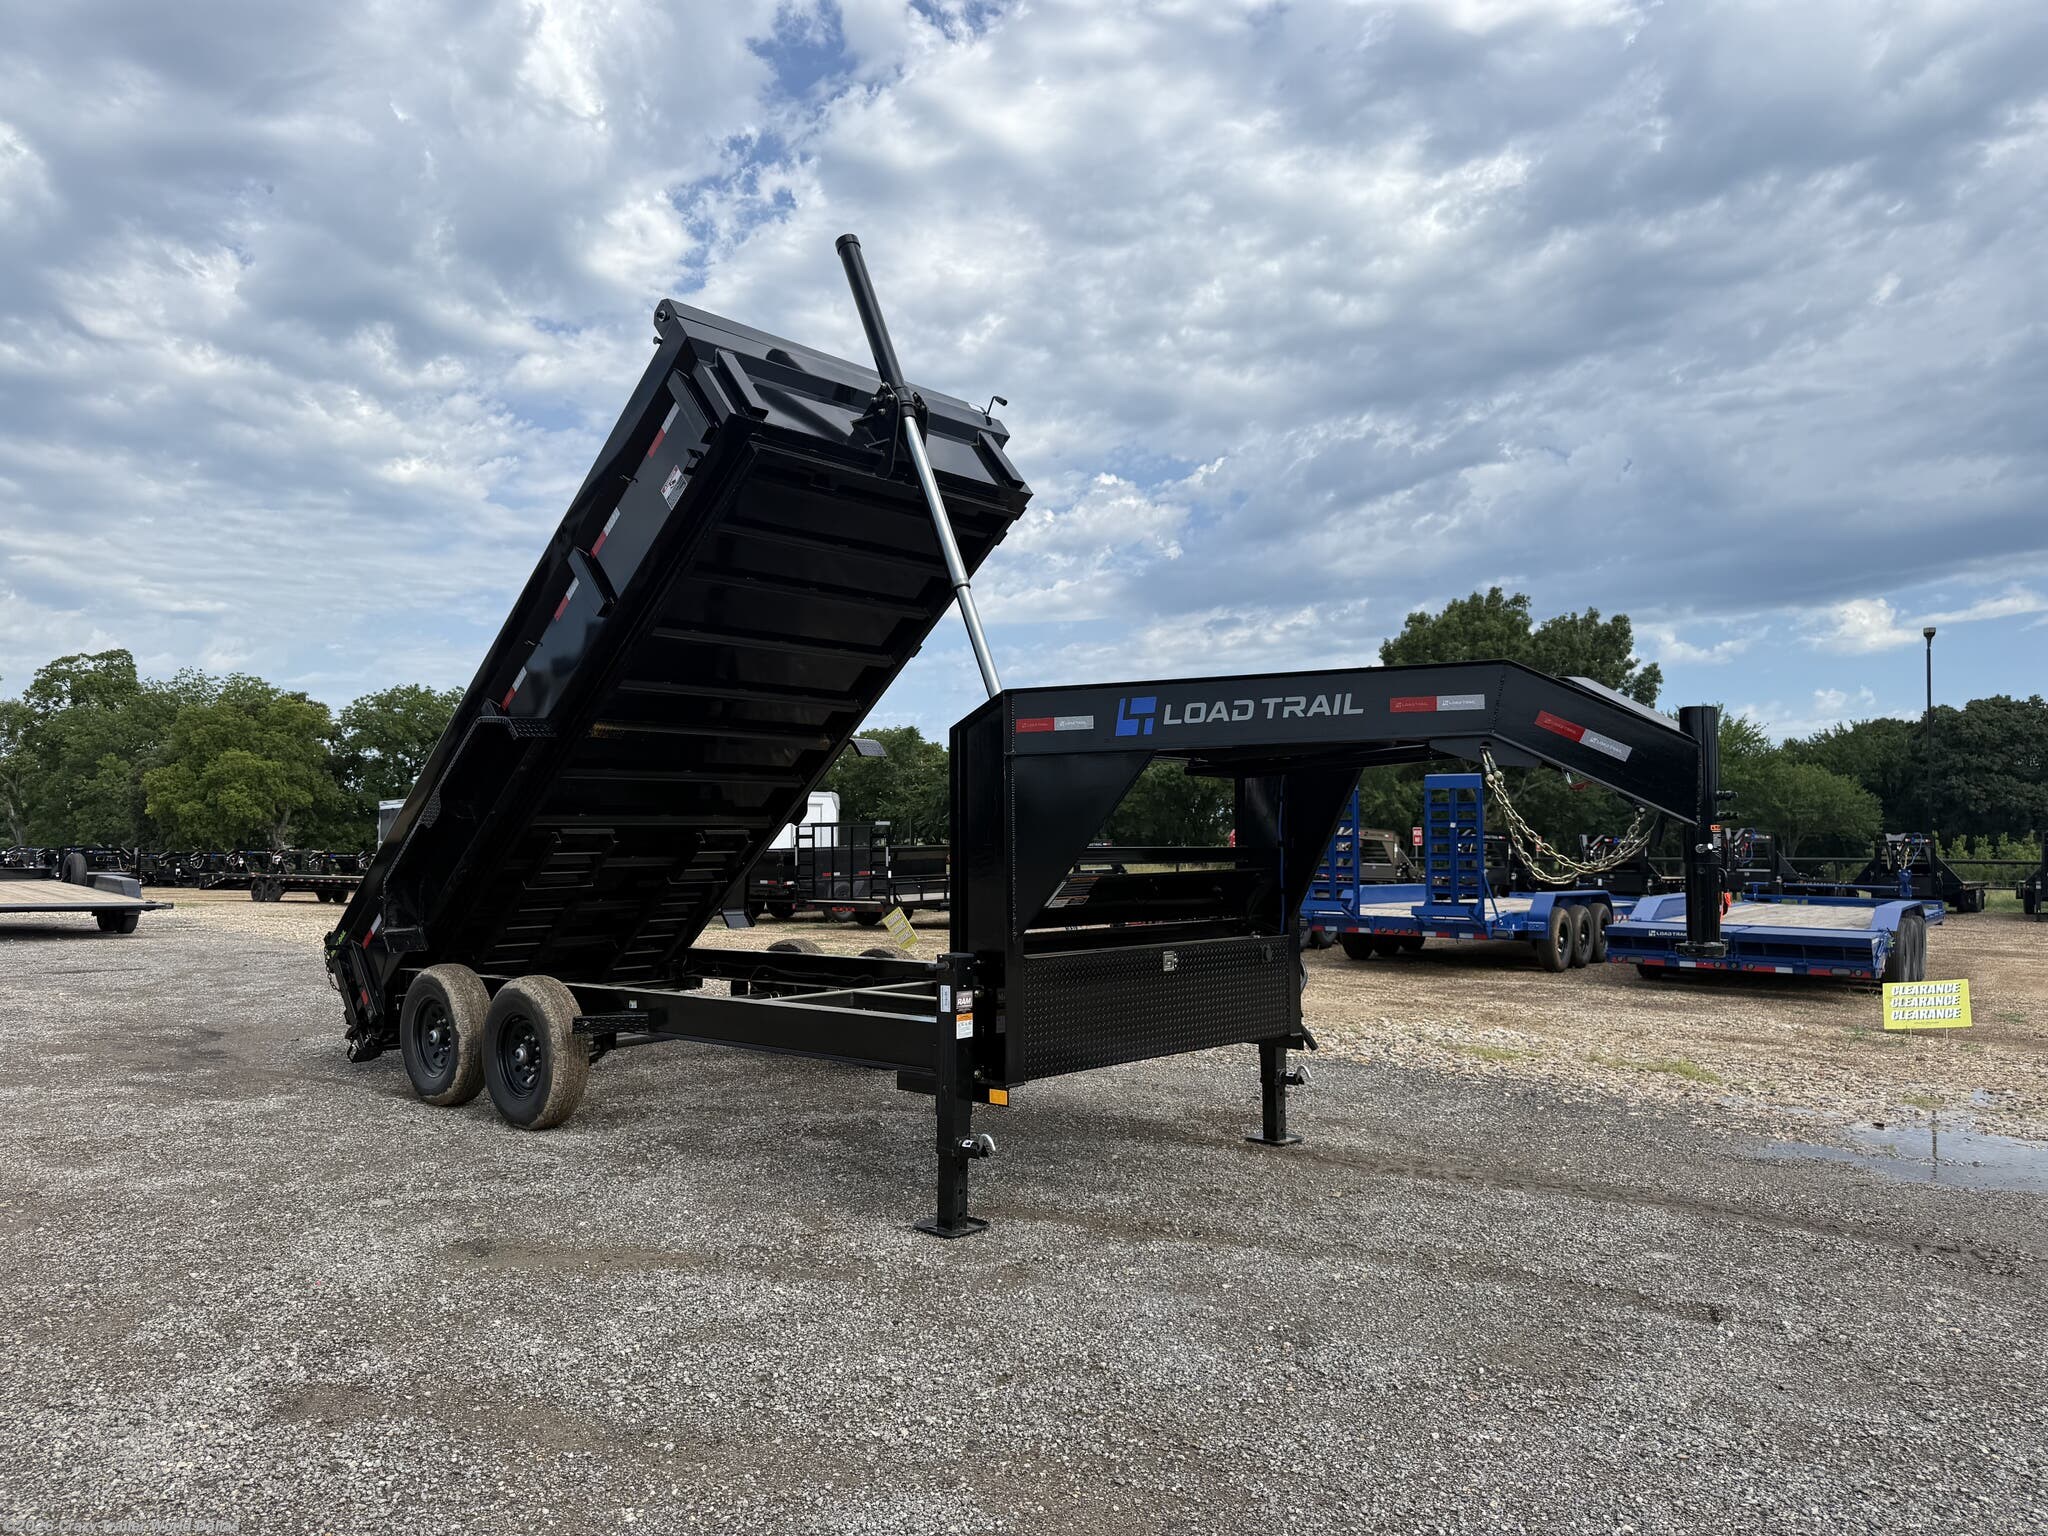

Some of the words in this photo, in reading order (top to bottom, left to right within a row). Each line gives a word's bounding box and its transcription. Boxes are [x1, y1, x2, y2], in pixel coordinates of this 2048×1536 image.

[1163, 699, 1254, 725] LOAD
[1261, 693, 1364, 719] TRAIL
[1892, 983, 1961, 996] CLEARANCE
[956, 997, 972, 1006] RAM
[1891, 996, 1961, 1008] CLEARANCE
[1892, 1008, 1961, 1020] CLEARANCE
